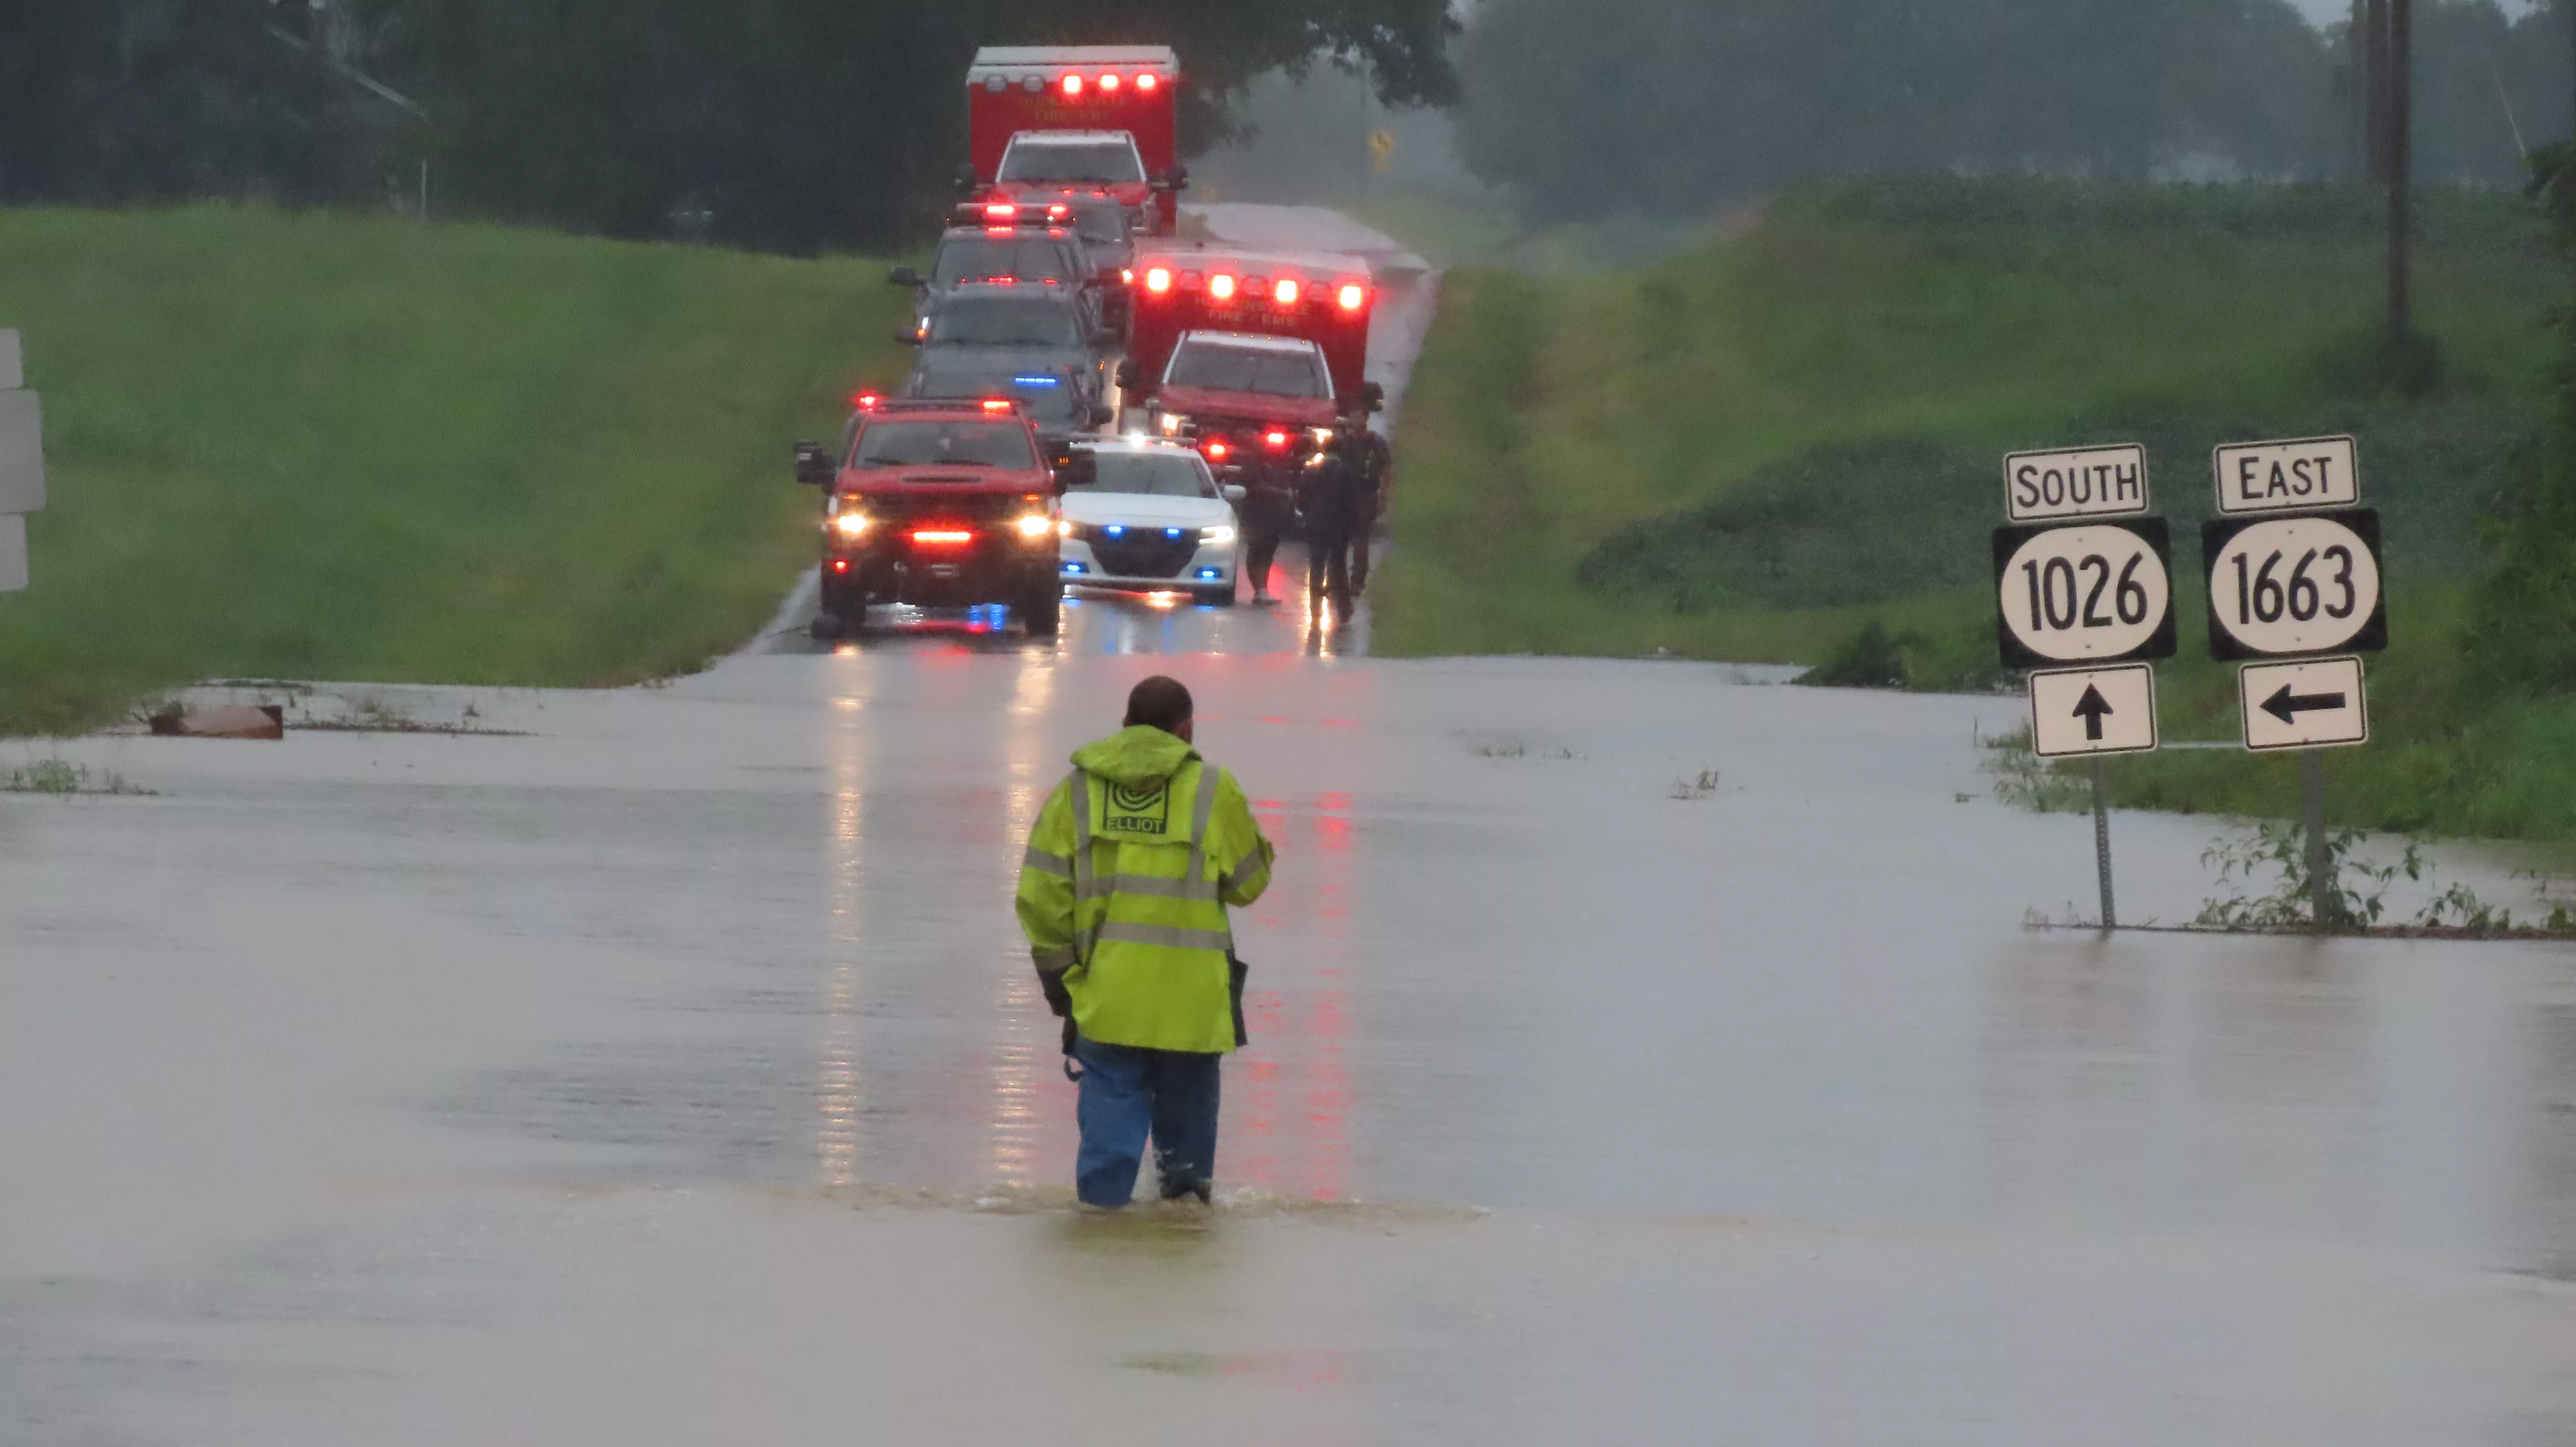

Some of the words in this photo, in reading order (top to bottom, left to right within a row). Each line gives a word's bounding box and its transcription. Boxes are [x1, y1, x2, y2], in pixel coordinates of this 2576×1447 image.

[2016, 463, 2139, 508] SOUTH
[2239, 456, 2333, 500] EAST
[2021, 550, 2148, 632] 1026
[2231, 544, 2356, 625] 1663
[1106, 816, 1163, 833] ELLIOT
